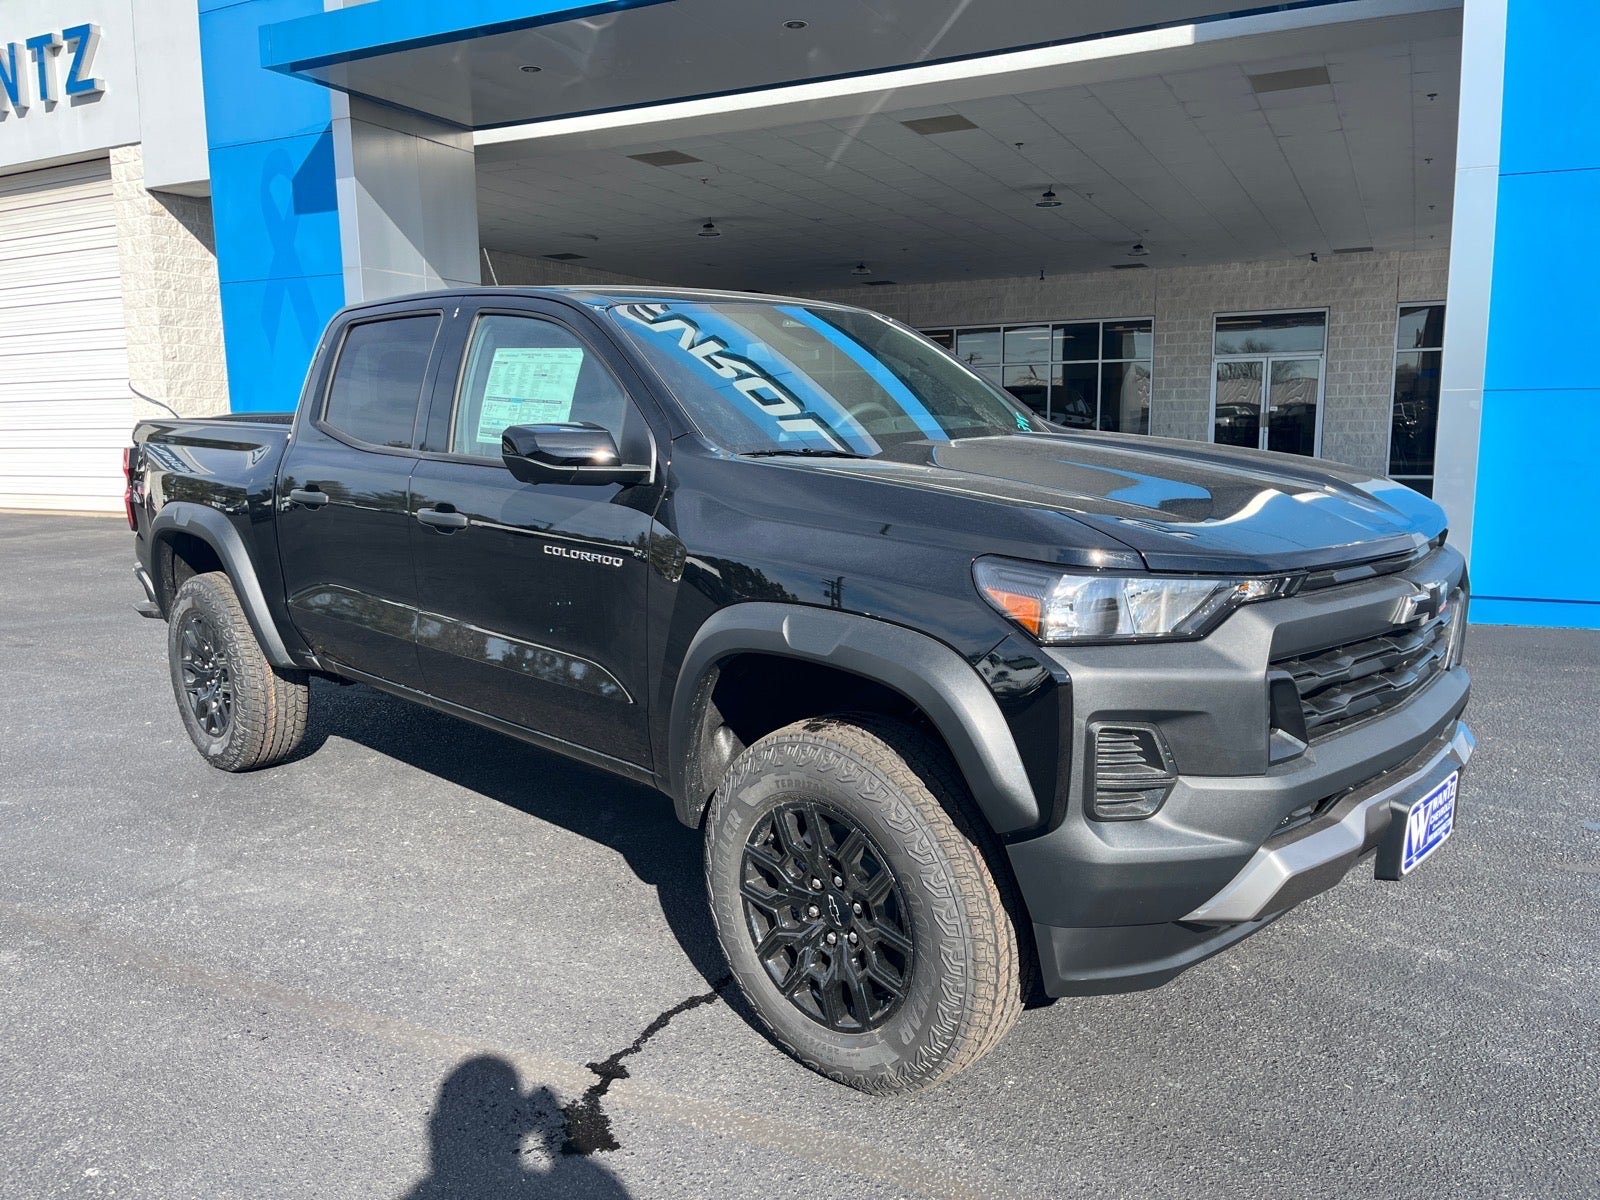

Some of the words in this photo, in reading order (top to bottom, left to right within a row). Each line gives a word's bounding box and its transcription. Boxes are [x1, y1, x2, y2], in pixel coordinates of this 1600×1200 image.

[543, 545, 623, 567] COLORADO
[1431, 783, 1456, 811] WANTZ
[1410, 804, 1433, 855] W
